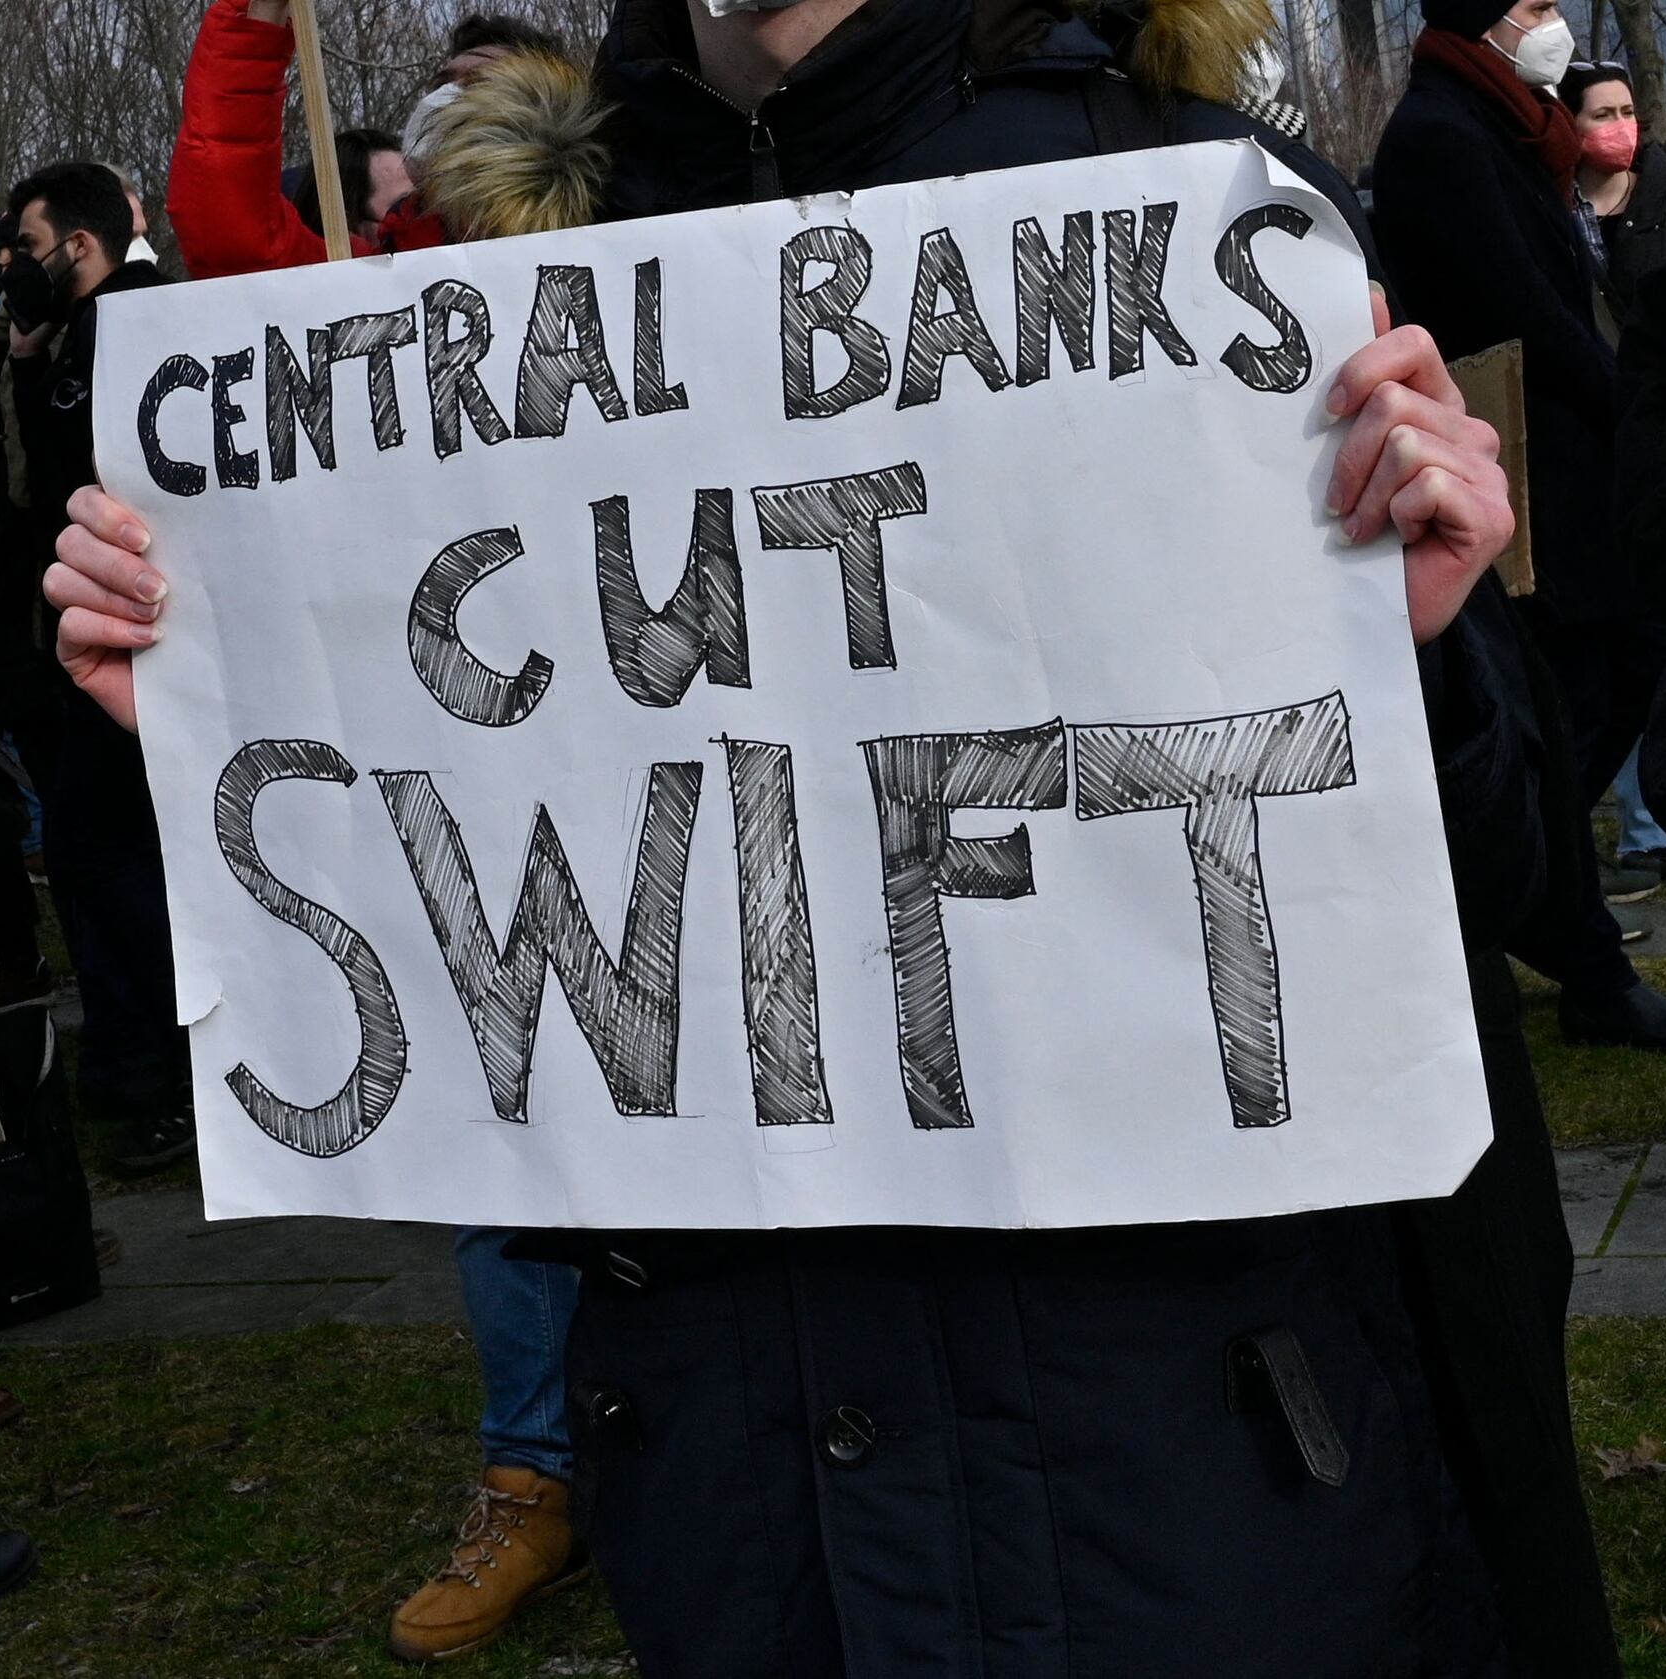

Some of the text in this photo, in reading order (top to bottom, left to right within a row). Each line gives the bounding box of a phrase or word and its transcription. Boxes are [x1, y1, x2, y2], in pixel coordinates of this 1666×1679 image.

[136, 198, 1317, 496] CENTRAL BANKS
[406, 461, 927, 728] CUT
[215, 691, 1357, 1157] SWIFT
